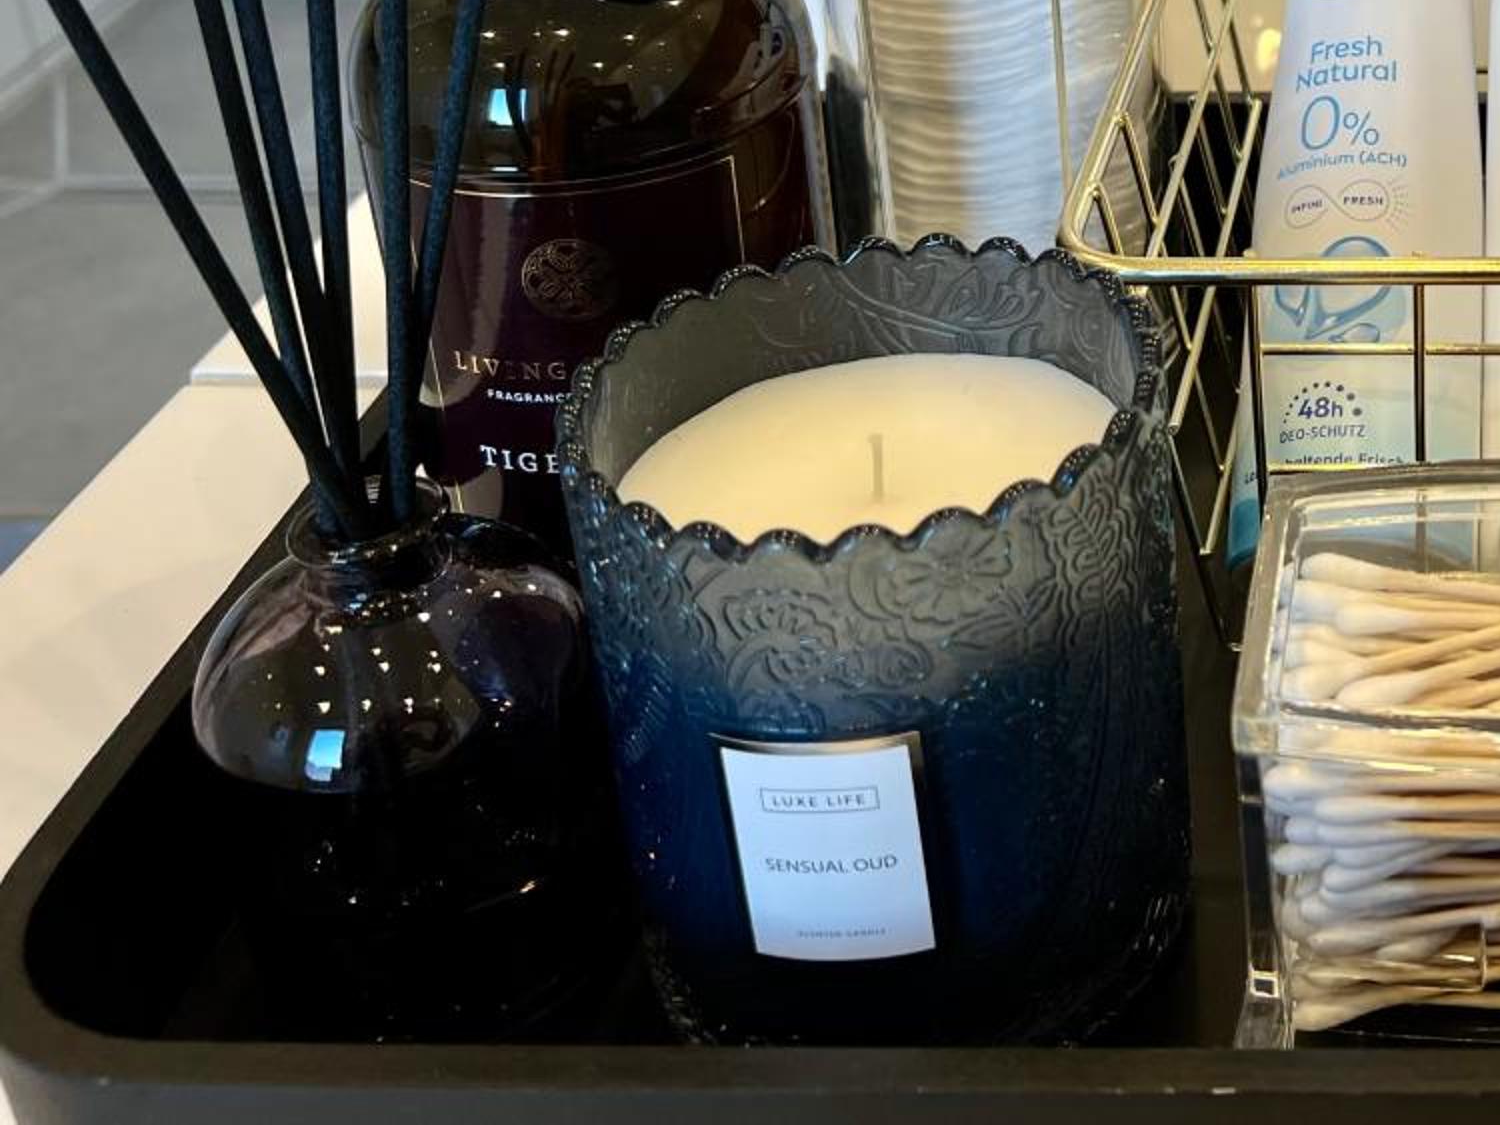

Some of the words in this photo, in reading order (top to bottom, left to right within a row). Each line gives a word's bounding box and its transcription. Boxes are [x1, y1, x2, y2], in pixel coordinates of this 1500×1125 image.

[1311, 35, 1383, 64] Fresh
[1295, 61, 1398, 93] Natural
[1301, 95, 1380, 151] 0%
[1359, 150, 1407, 168] (ACH)
[1343, 196, 1384, 206] FRESH
[454, 350, 567, 381] LIVING
[1298, 396, 1343, 419] 48h
[1280, 425, 1366, 444] DEO-SCHUTZ
[772, 795, 817, 808] LUXE
[827, 793, 866, 807] LIFE
[765, 858, 848, 874] SENSUAL
[853, 854, 899, 872] OUD
